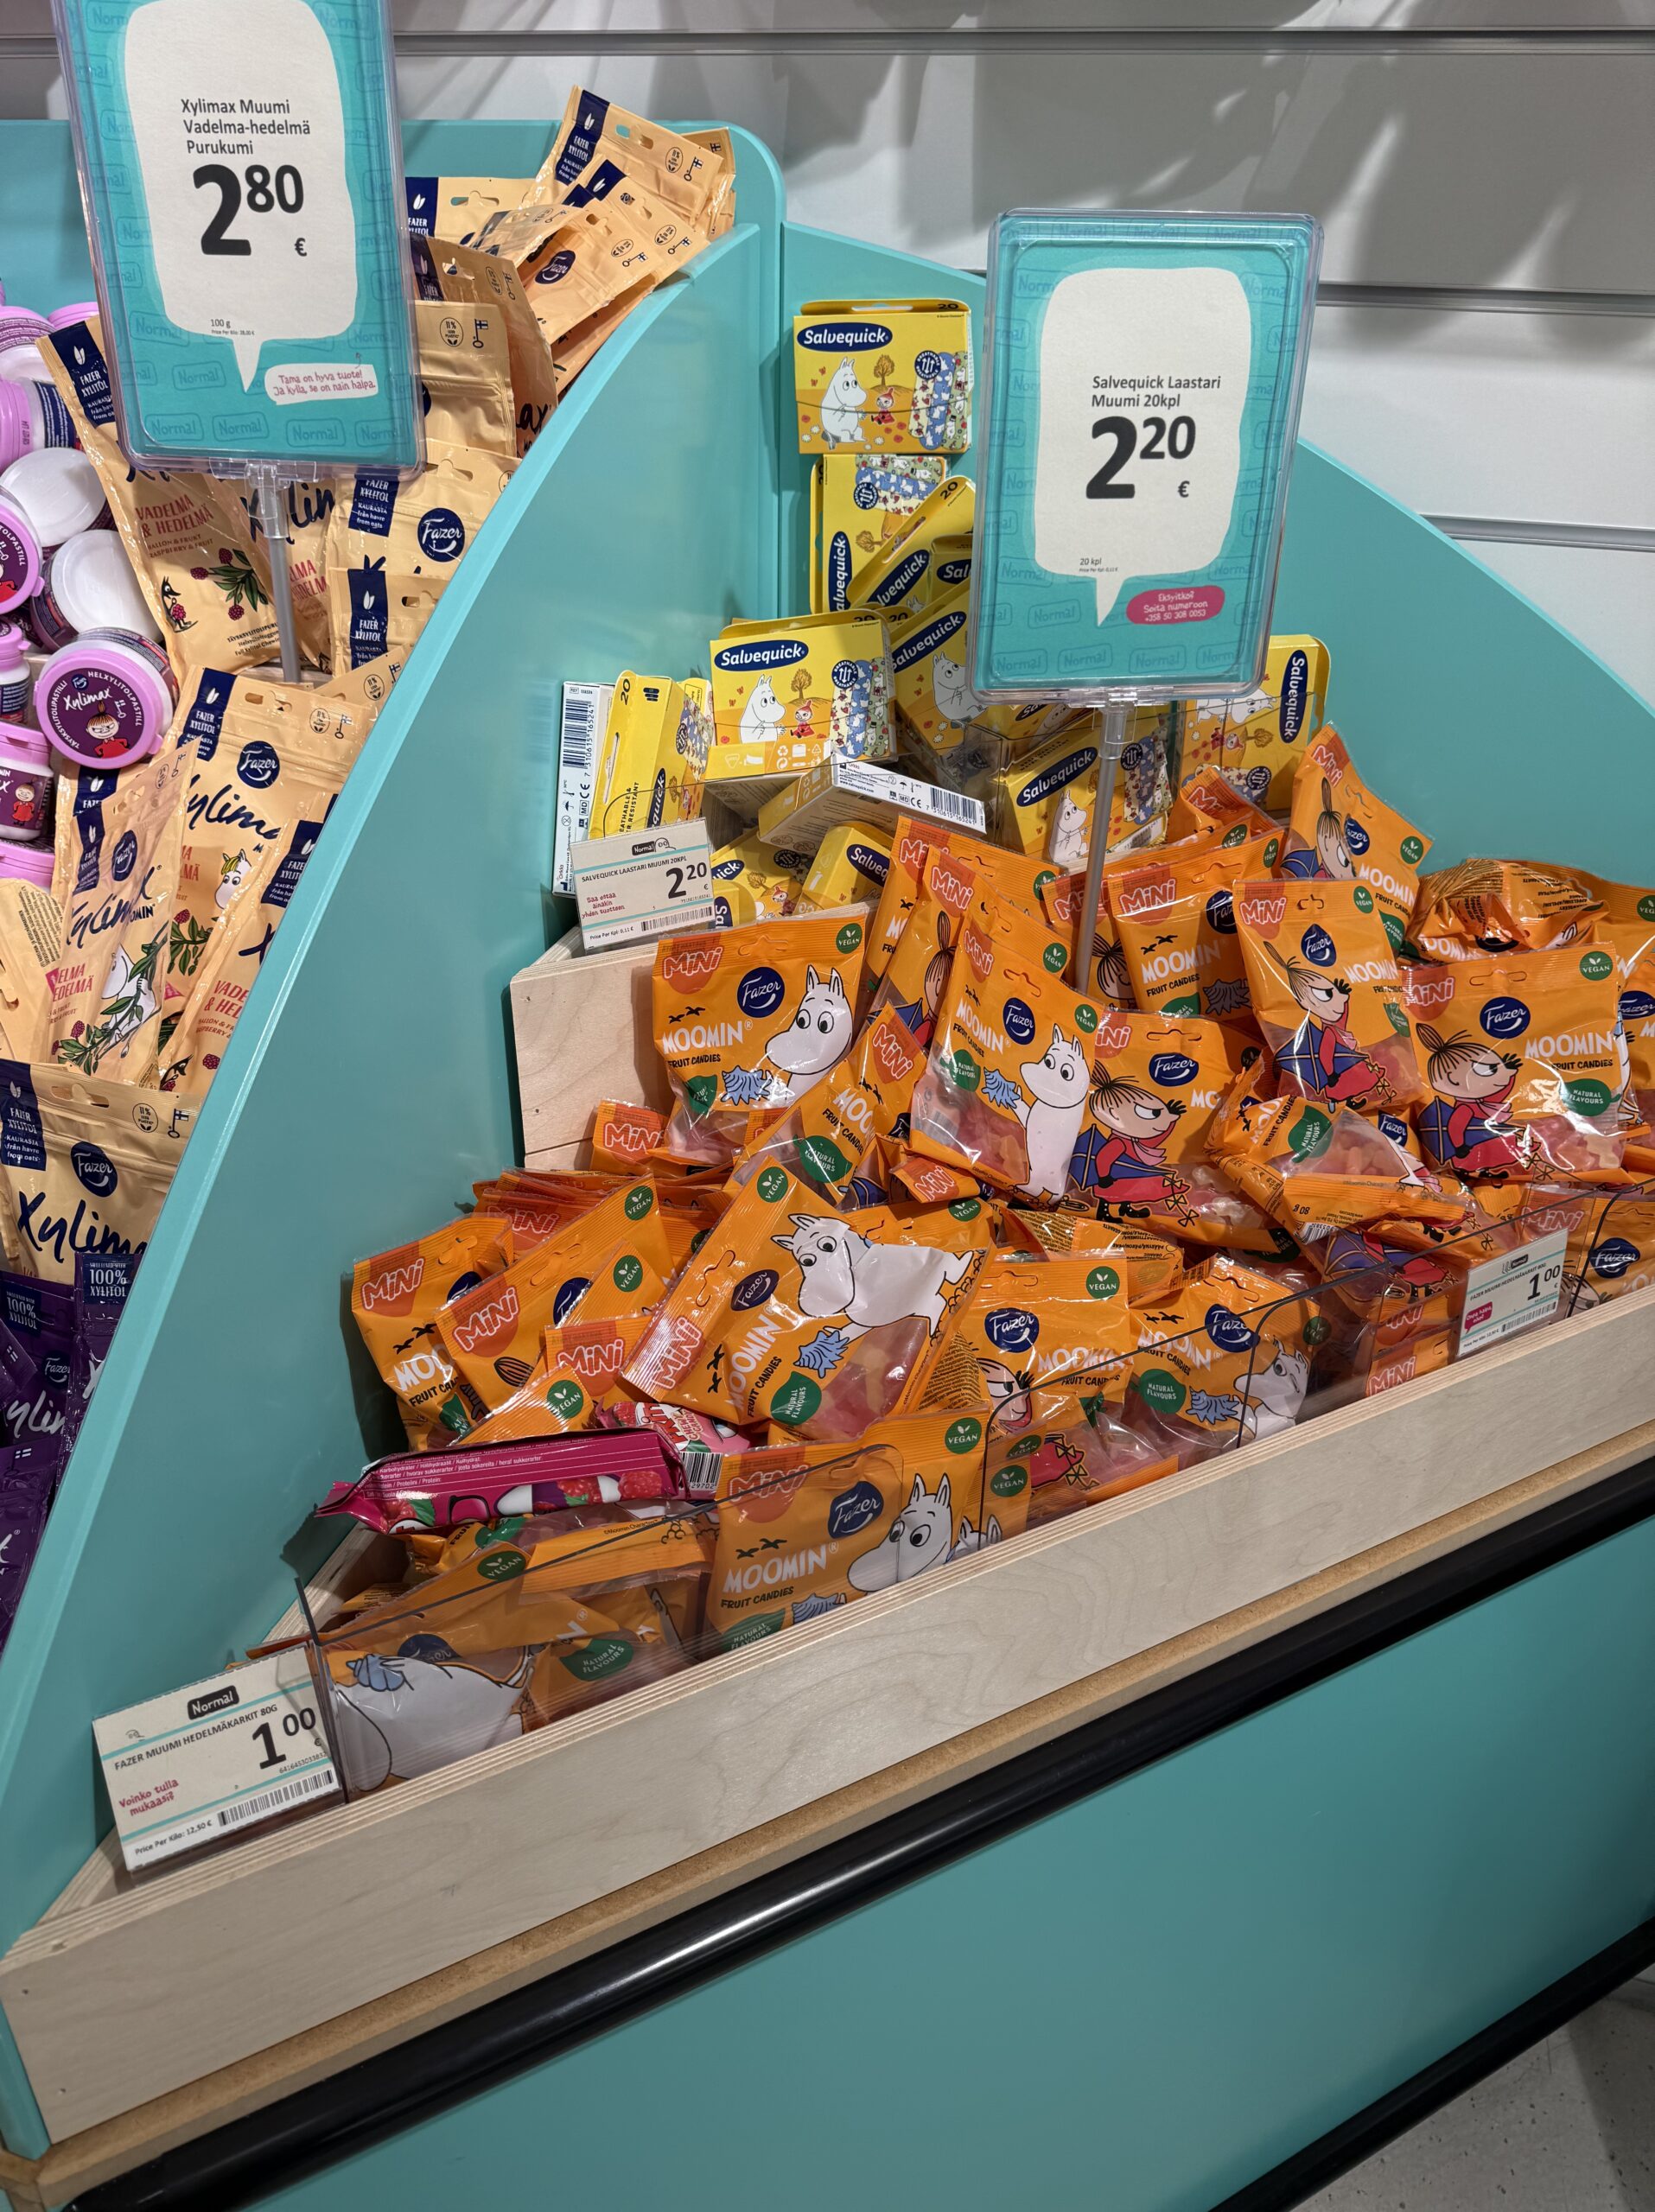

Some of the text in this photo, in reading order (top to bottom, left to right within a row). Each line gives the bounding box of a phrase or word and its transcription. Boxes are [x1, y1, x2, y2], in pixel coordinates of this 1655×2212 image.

[181, 99, 290, 115] Xylimax Muumi
[183, 119, 310, 136] Vadelma-hedelmä
[187, 140, 253, 154] Purukumi
[193, 163, 304, 256] 2 80
[294, 238, 307, 257] €
[804, 328, 886, 346] Salvequick
[80, 371, 101, 385] FAZER
[178, 367, 219, 384] Normal
[335, 370, 362, 379] tuote!
[1092, 375, 1221, 391] Salvequick Laastari
[81, 379, 109, 397] XYLITOL
[274, 387, 285, 396] Ja
[310, 384, 318, 392] se
[1092, 393, 1181, 410] Muumi 20kpl
[218, 417, 263, 438] Normal
[1085, 416, 1196, 499] 2 20
[366, 479, 390, 491] FAZER
[940, 480, 959, 499] 20
[1178, 480, 1190, 499] €
[360, 488, 390, 503] XYLITOL
[135, 494, 194, 520] VADELMA
[156, 504, 213, 534] HEDELMÄ
[423, 518, 461, 542] Fazer
[1158, 591, 1194, 601] Eksyitko?
[360, 620, 379, 630] FAZER
[355, 630, 381, 642] XYLITOL
[721, 644, 802, 665] Salvequick
[1135, 653, 1181, 669] Normal
[63, 688, 112, 710] Xylimax
[621, 679, 630, 705] 20
[1283, 658, 1304, 739] Salvequick
[189, 719, 216, 734] XYLITOL
[196, 710, 214, 723] FAZER
[240, 750, 277, 770] Fazer
[1022, 751, 1093, 802] Salvequick
[582, 870, 618, 882] SALVEQUICK
[620, 864, 646, 874] LAASTARI
[648, 860, 670, 868] MUUMI
[666, 862, 707, 899] 2 20
[1359, 864, 1417, 906] MOOMIN
[582, 905, 625, 918] yhden tuotteen
[838, 937, 860, 947] VEGAN
[1142, 944, 1220, 984] MOOMIN
[1344, 959, 1397, 984] MOOMIN
[742, 976, 780, 1006] Fazer
[1146, 974, 1200, 997] FRUIT CANDIES
[1006, 1004, 1034, 1028] Fazer
[1486, 1007, 1525, 1029] Fazer
[956, 999, 1004, 1054] MOOMIN
[663, 1021, 742, 1055] MOOMIN
[952, 1023, 985, 1058] FRUIT CANDIES
[1525, 1032, 1613, 1058] MOOMIN
[668, 1053, 721, 1068] FRUIT CANDIES
[1552, 1059, 1613, 1071] FRUIT CANDIES
[1569, 1095, 1603, 1104] FLAVOURS
[1573, 1090, 1601, 1098] NATURAL
[10, 1108, 31, 1122] FAZER
[822, 1109, 843, 1131] FRUIT
[8, 1119, 38, 1134] XYLITOL
[1264, 1126, 1279, 1147] FRUIT
[74, 1153, 112, 1177] Fazer
[90, 1269, 127, 1285] 100%
[1089, 1282, 1117, 1292] VEGAN
[1528, 1265, 1560, 1300] 1 00
[90, 1286, 126, 1297] XYLITOL
[8, 1300, 35, 1319] 100%
[991, 1313, 1034, 1344] Fazer
[747, 1356, 782, 1417] FRUIT CANDIES
[1148, 1384, 1174, 1394] NATURAL
[409, 1388, 438, 1407] FRUIT
[948, 1432, 977, 1446] VEGAN
[723, 1544, 827, 1594] MOOMIN
[721, 1586, 793, 1610] FRUIT CANDIES
[191, 1693, 234, 1715] Normal
[114, 1704, 278, 1770] FAZER MUUMI HEDELMÄKARKIT 80G
[251, 1707, 316, 1770] 1 00
[314, 1738, 321, 1747] €
[119, 1778, 179, 1808] Voinko tulla
[130, 1792, 175, 1816] mukaasi?
[135, 1843, 153, 1856] Price
[155, 1839, 167, 1848] Per
[169, 1833, 185, 1843] Kilo:
